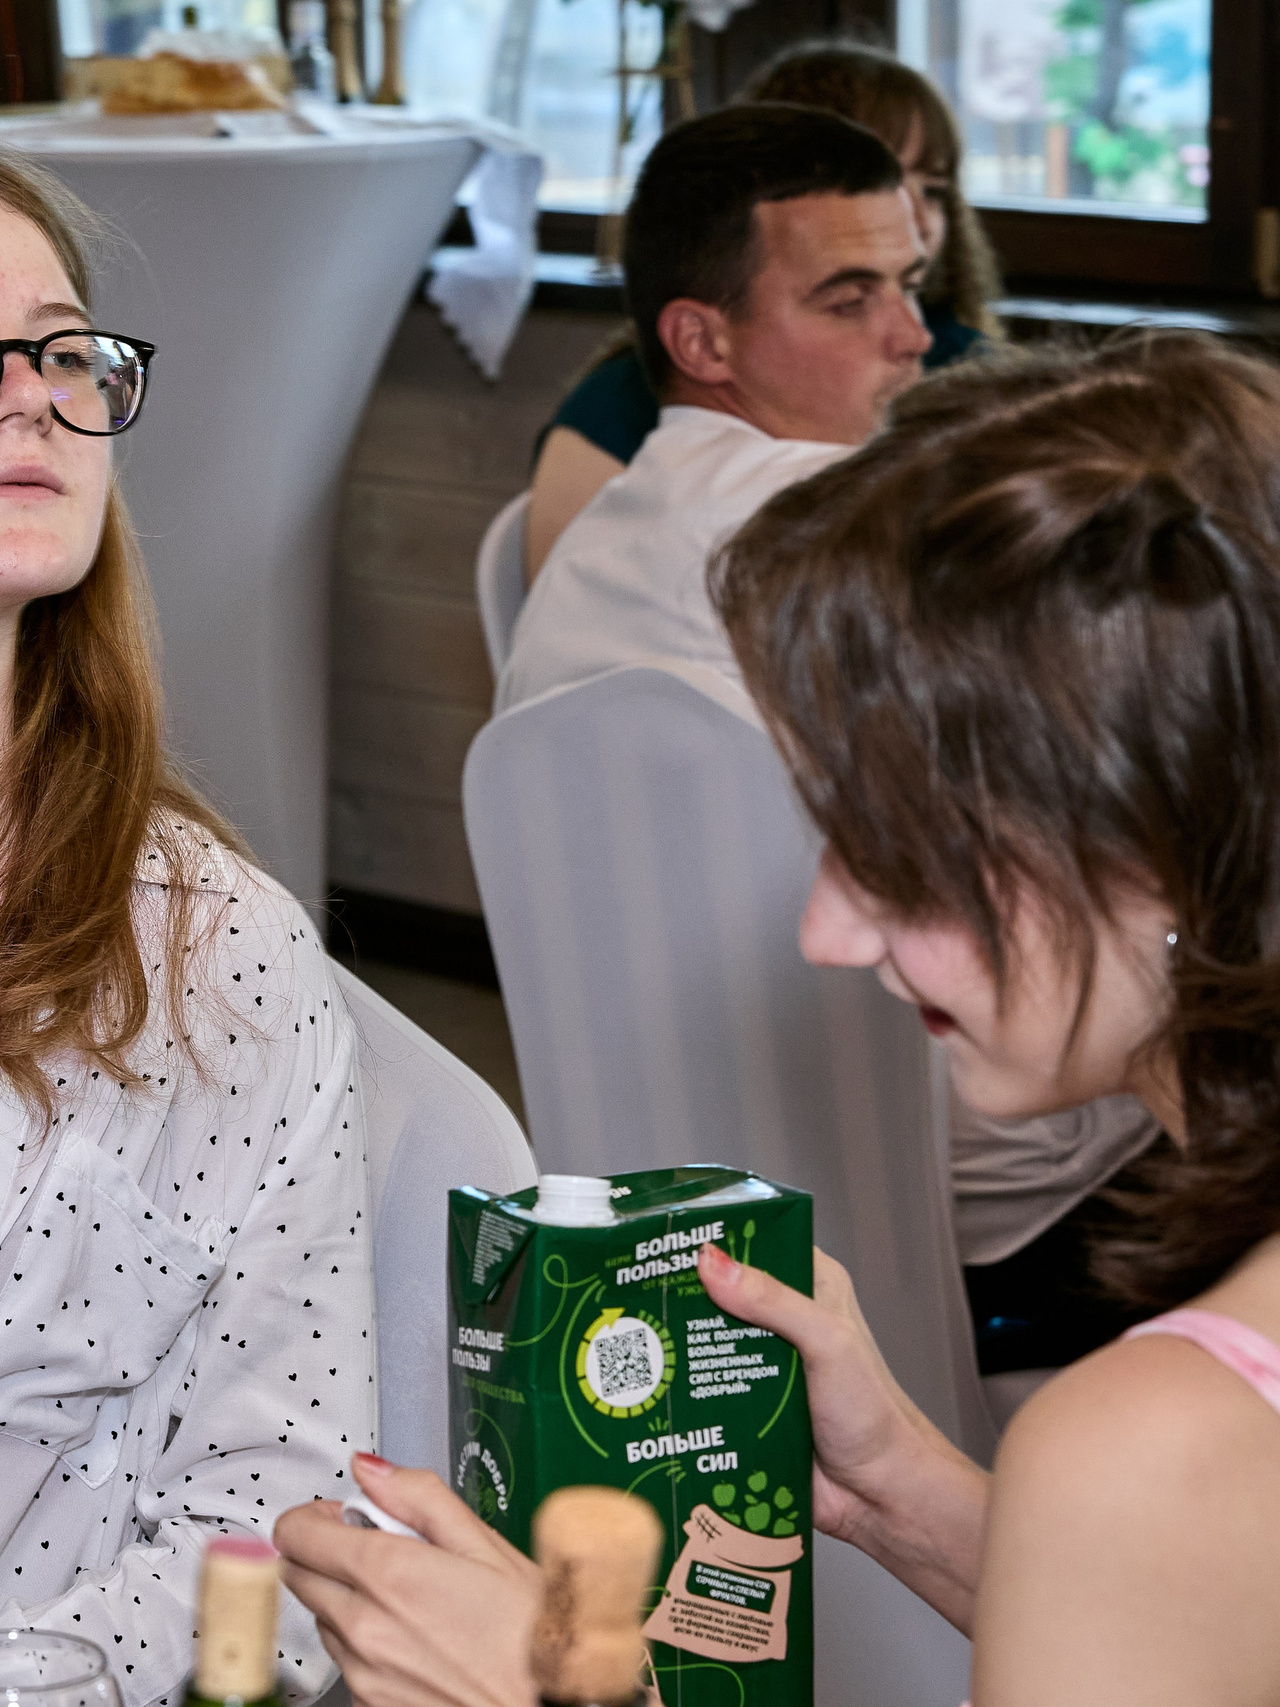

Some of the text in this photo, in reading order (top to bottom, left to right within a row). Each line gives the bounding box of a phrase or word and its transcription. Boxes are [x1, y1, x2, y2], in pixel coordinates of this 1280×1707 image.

[635, 1221, 725, 1261] БОЛЬШЕ
[616, 1250, 698, 1285] ПОЛЬЗЫ
[686, 1315, 727, 1331] УЗНАЙ,
[459, 1327, 504, 1352] БОЛЬШЕ
[687, 1332, 711, 1345] КАК
[687, 1342, 736, 1358] БОЛЬШЕ
[452, 1348, 491, 1372] ПОЛЬЗЫ
[688, 1353, 764, 1371] ЖИЗНЕННЫХ
[689, 1371, 713, 1385] СИЛ
[722, 1365, 779, 1381] БРЕНДОМ
[690, 1380, 751, 1399] «ДОБРЫЙ»
[626, 1425, 725, 1463] БОЛЬШЕ
[696, 1451, 738, 1473] СИЛ
[481, 1448, 508, 1511] ДОБРО
[695, 1574, 729, 1591] СОЧНЫХ
[734, 1585, 767, 1600] СПЕЛЫХ
